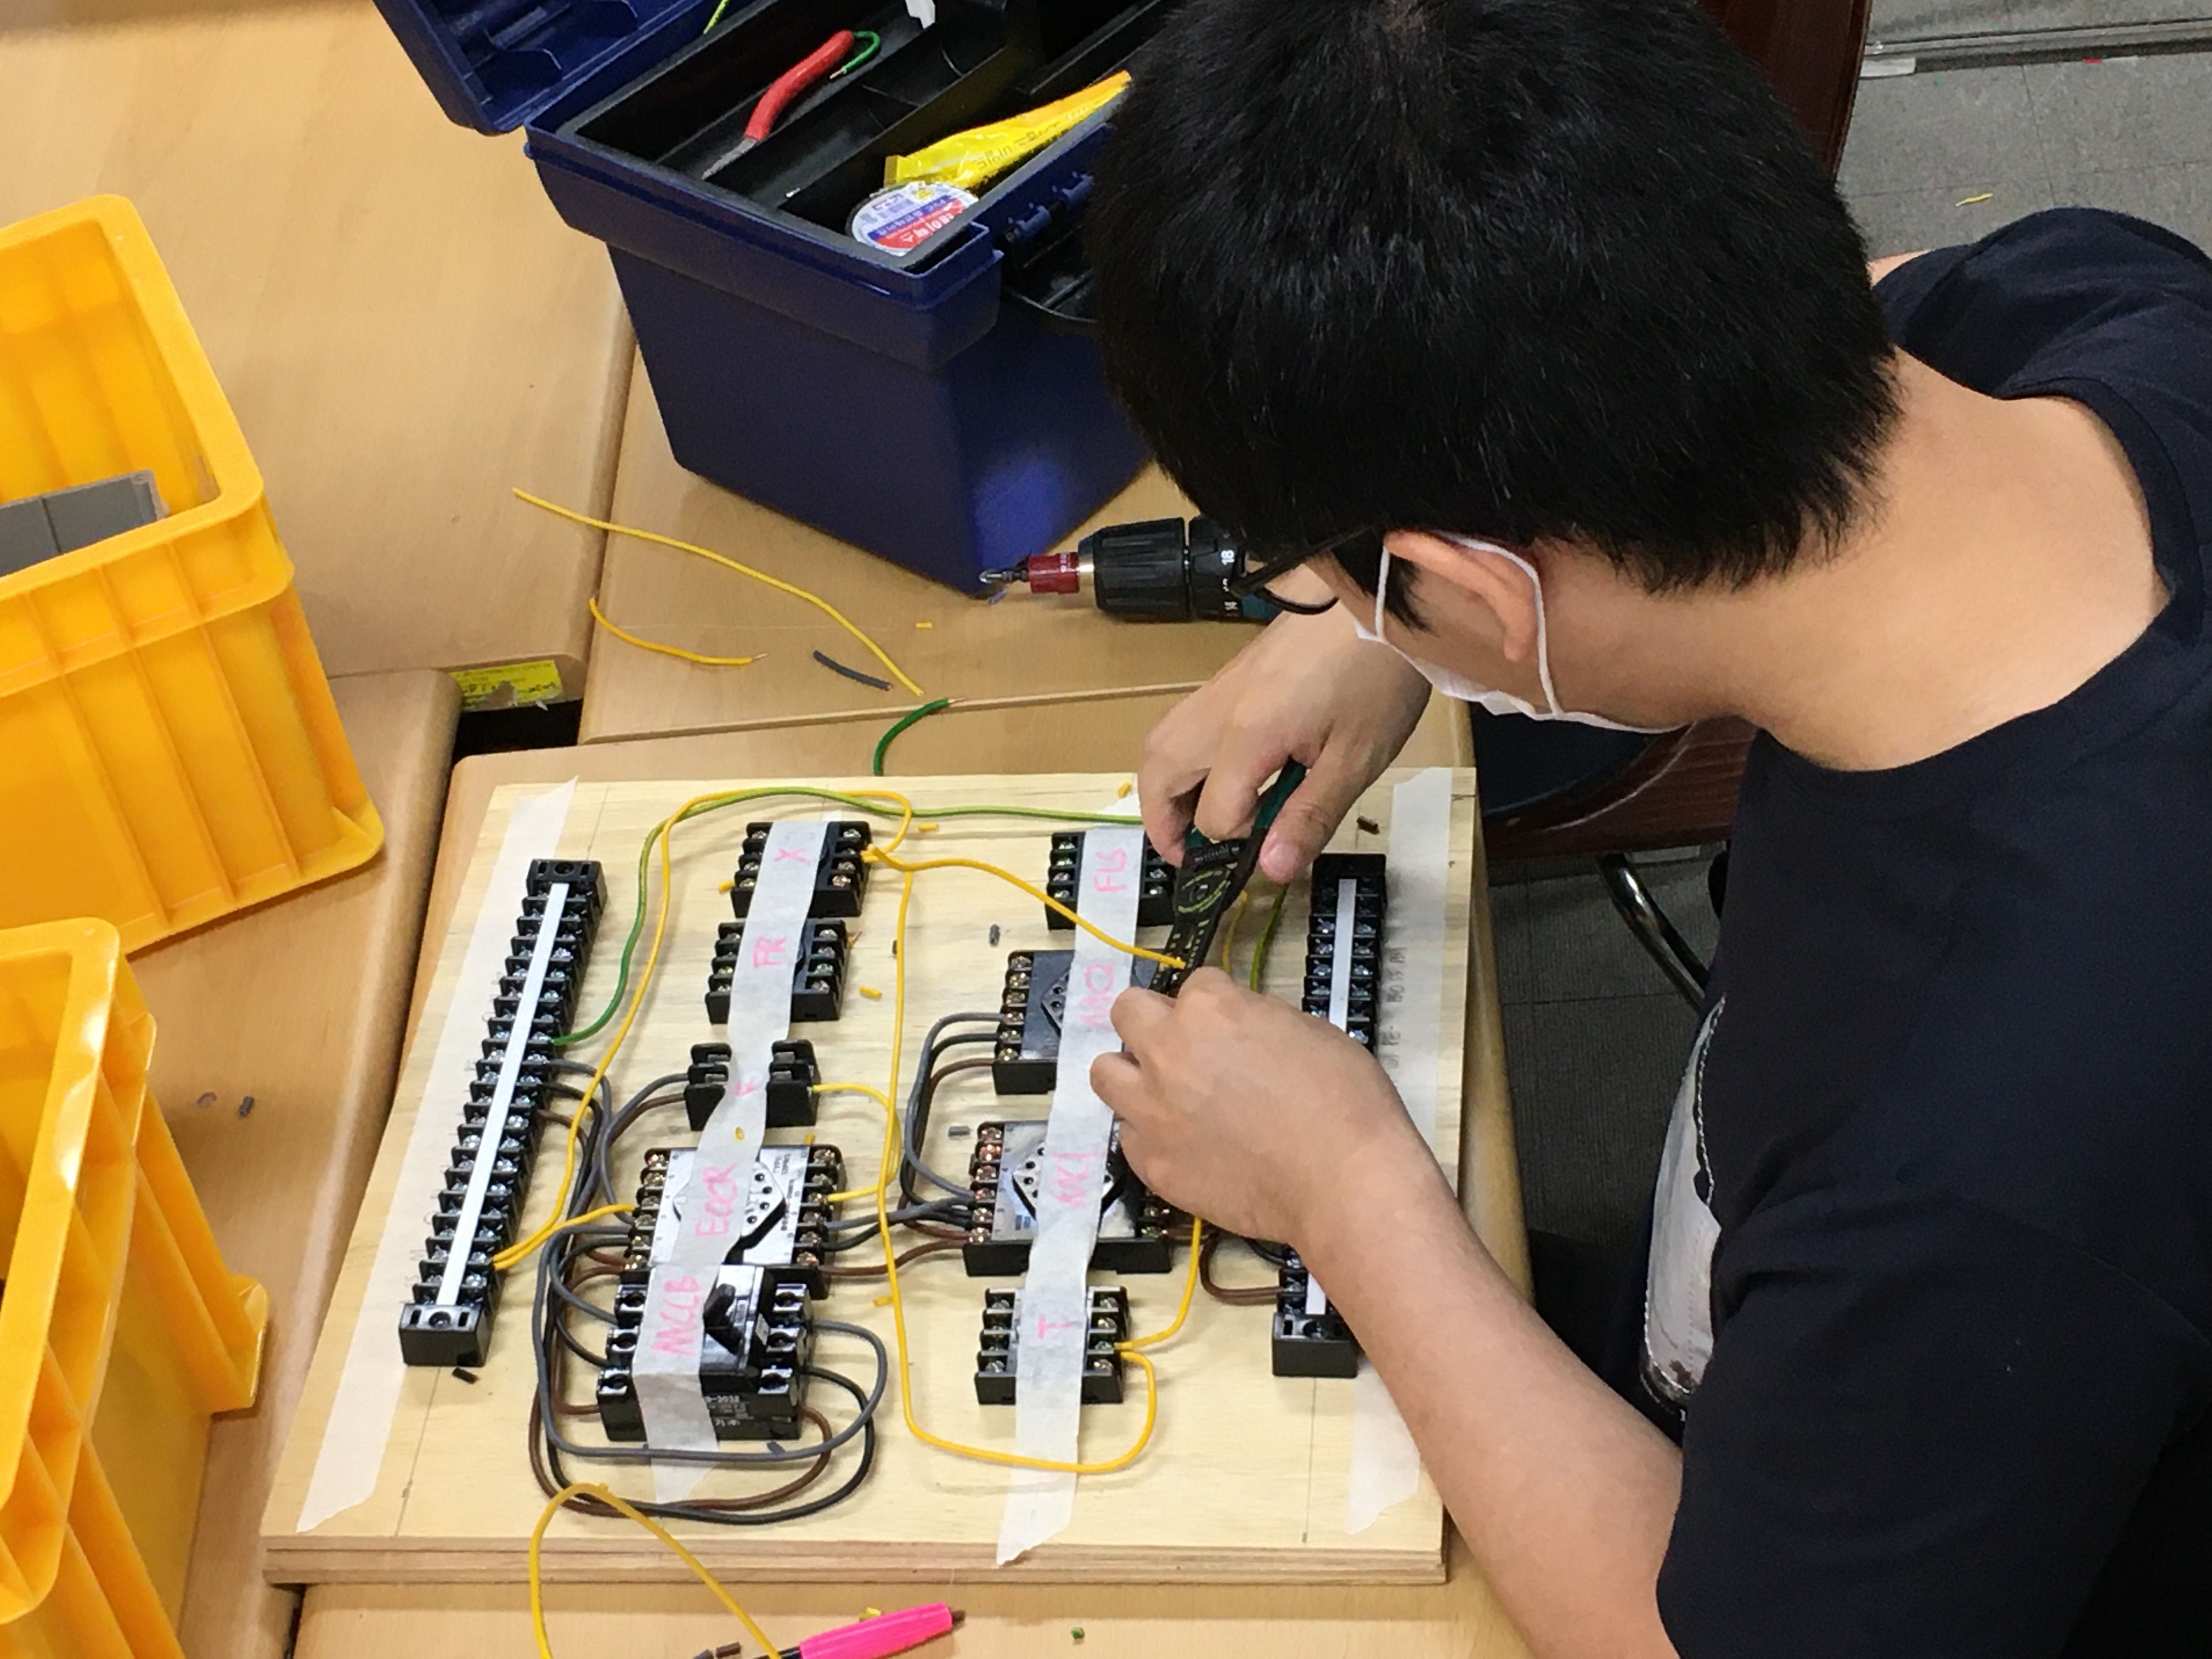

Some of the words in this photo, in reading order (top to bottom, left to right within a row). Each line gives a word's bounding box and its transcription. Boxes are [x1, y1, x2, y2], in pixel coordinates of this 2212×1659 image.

[774, 845, 806, 864] X
[752, 935, 788, 968] FR
[650, 1275, 702, 1358] MCCB
[1036, 1315, 1074, 1340] T
